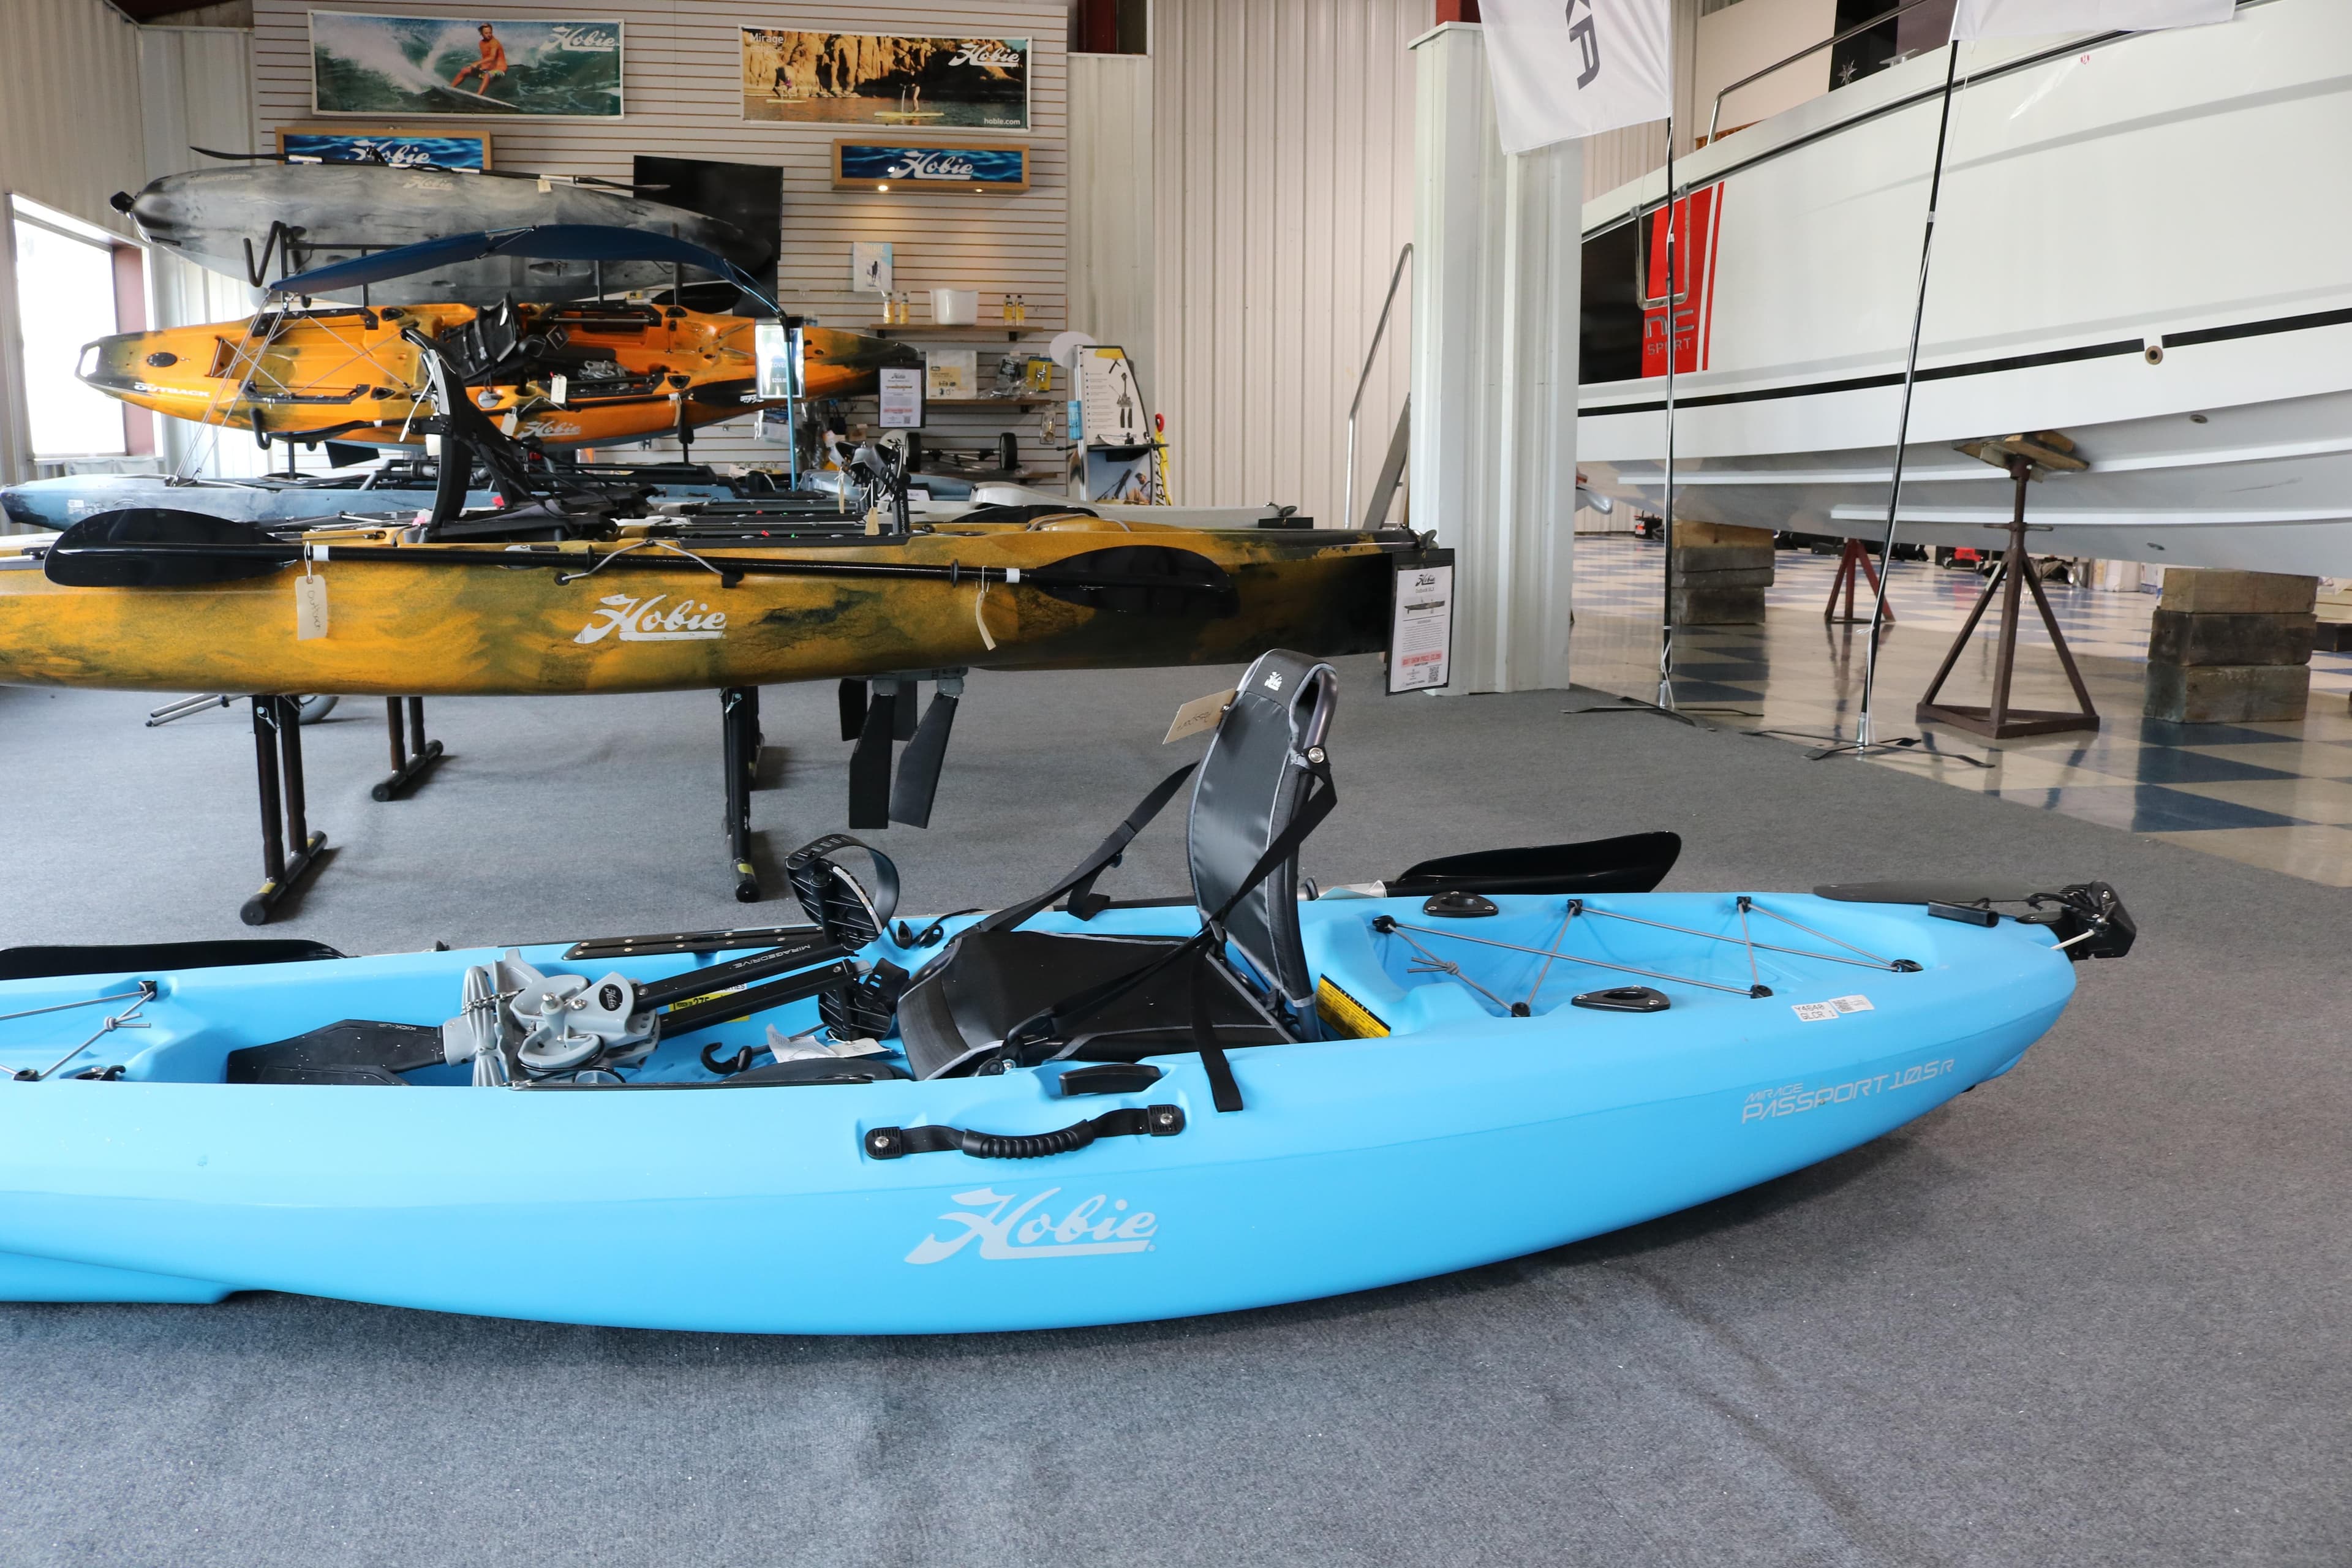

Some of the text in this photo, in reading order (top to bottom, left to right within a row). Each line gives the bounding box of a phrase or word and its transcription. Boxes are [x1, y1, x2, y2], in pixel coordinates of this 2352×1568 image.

[539, 26, 616, 51] Hobie
[750, 32, 784, 45] Mirage
[948, 43, 1019, 67] Hobie
[984, 117, 1020, 126] hobie.com
[890, 151, 974, 180] Hobie
[515, 420, 582, 439] Hobie
[574, 594, 727, 644] Hobie
[733, 944, 811, 968] MIRAGEDRIVE
[1741, 1074, 1890, 1125] PASSPORT
[1744, 1082, 1804, 1103] MIRAGE
[904, 1187, 1158, 1265] Hobie
